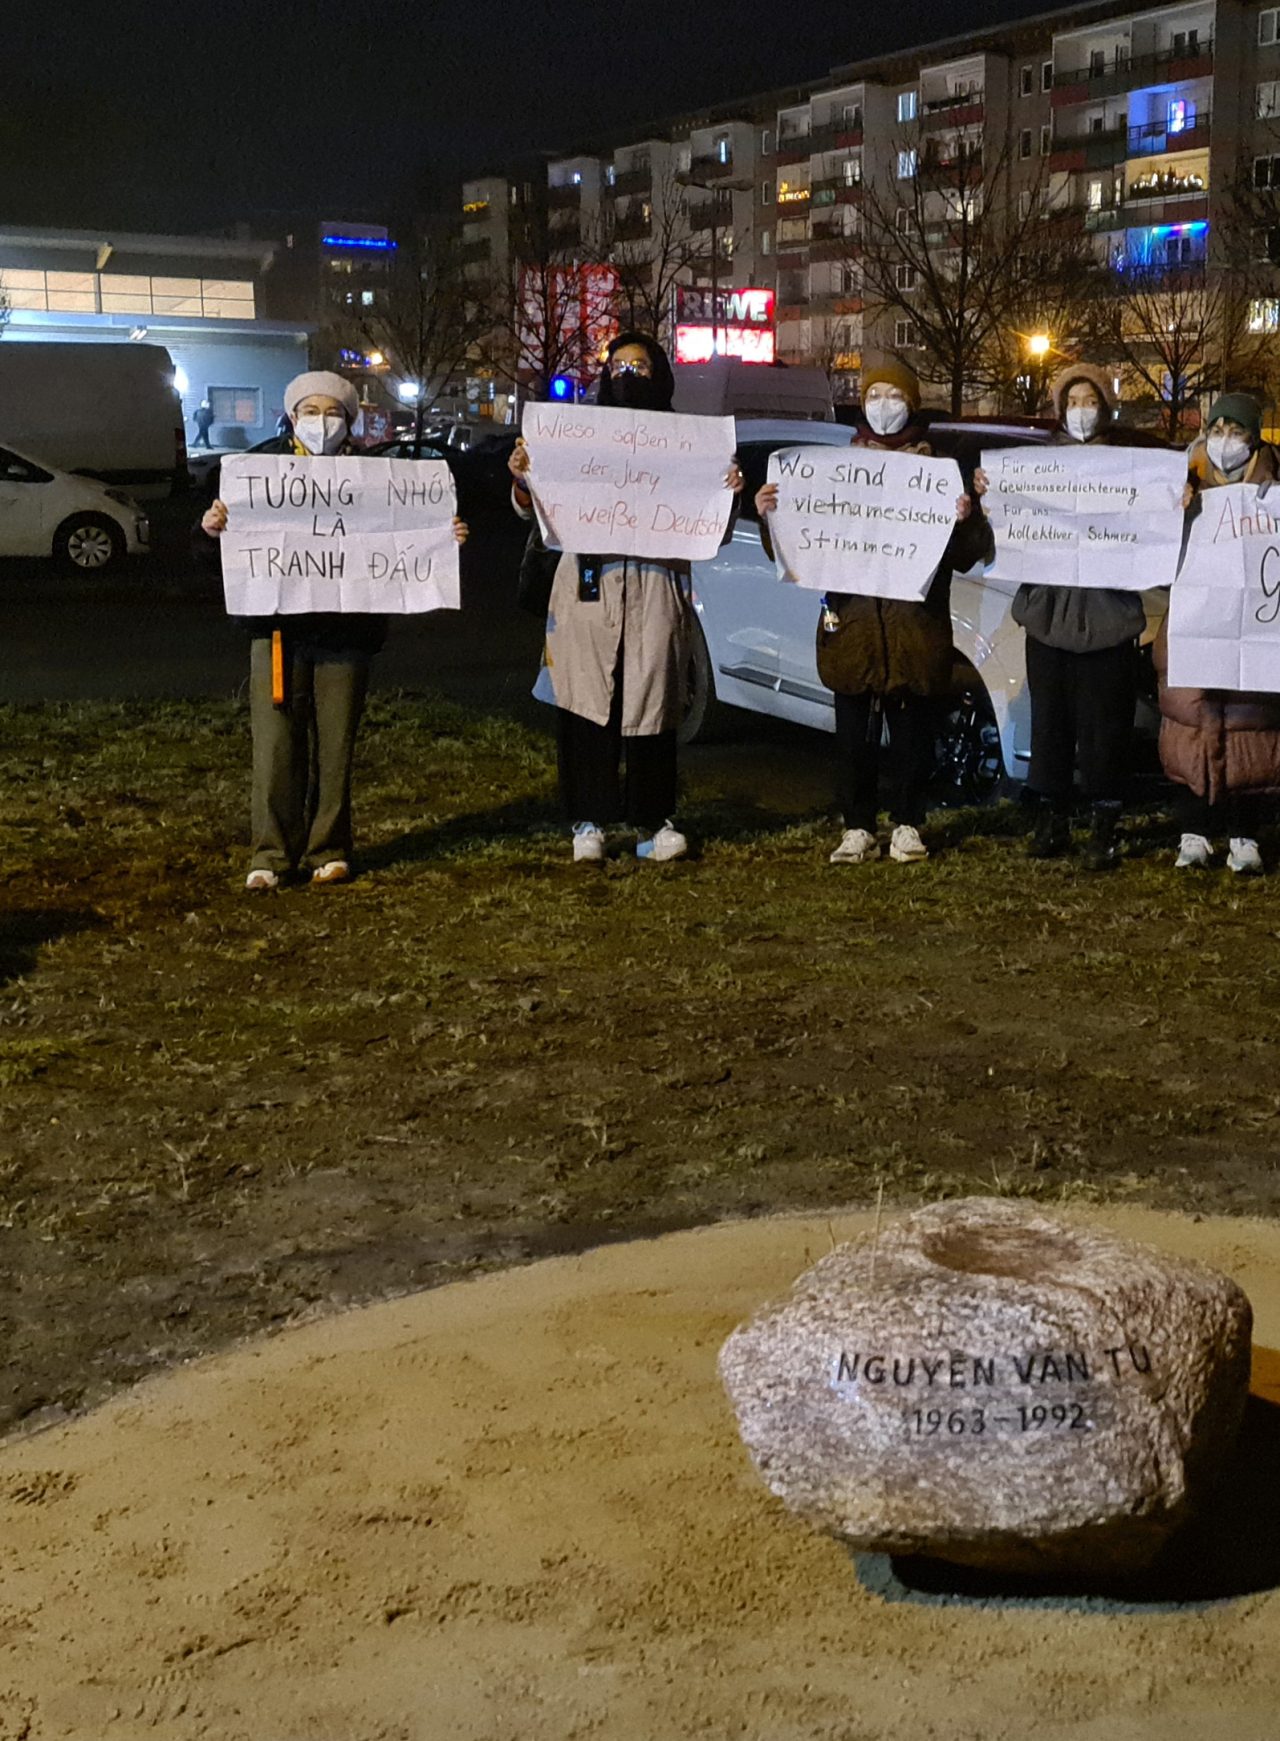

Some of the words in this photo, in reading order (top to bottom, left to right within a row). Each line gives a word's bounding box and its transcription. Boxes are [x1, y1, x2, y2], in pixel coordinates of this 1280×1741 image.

[536, 415, 596, 439] Wieso
[612, 425, 668, 454] saßen
[680, 436, 692, 451] in
[580, 457, 608, 476] der
[614, 458, 661, 492] Jury
[778, 453, 815, 479] Wo
[828, 462, 887, 487] sind
[908, 467, 949, 496] die
[1001, 456, 1025, 475] Für
[1034, 459, 1066, 474] euch:
[312, 511, 346, 537] LÀ
[578, 500, 639, 537] weiße
[1008, 523, 1074, 541] kollektiver
[798, 527, 918, 560] Stimmen?
[238, 547, 345, 580] TRANH
[368, 544, 432, 582] ĐẤU
